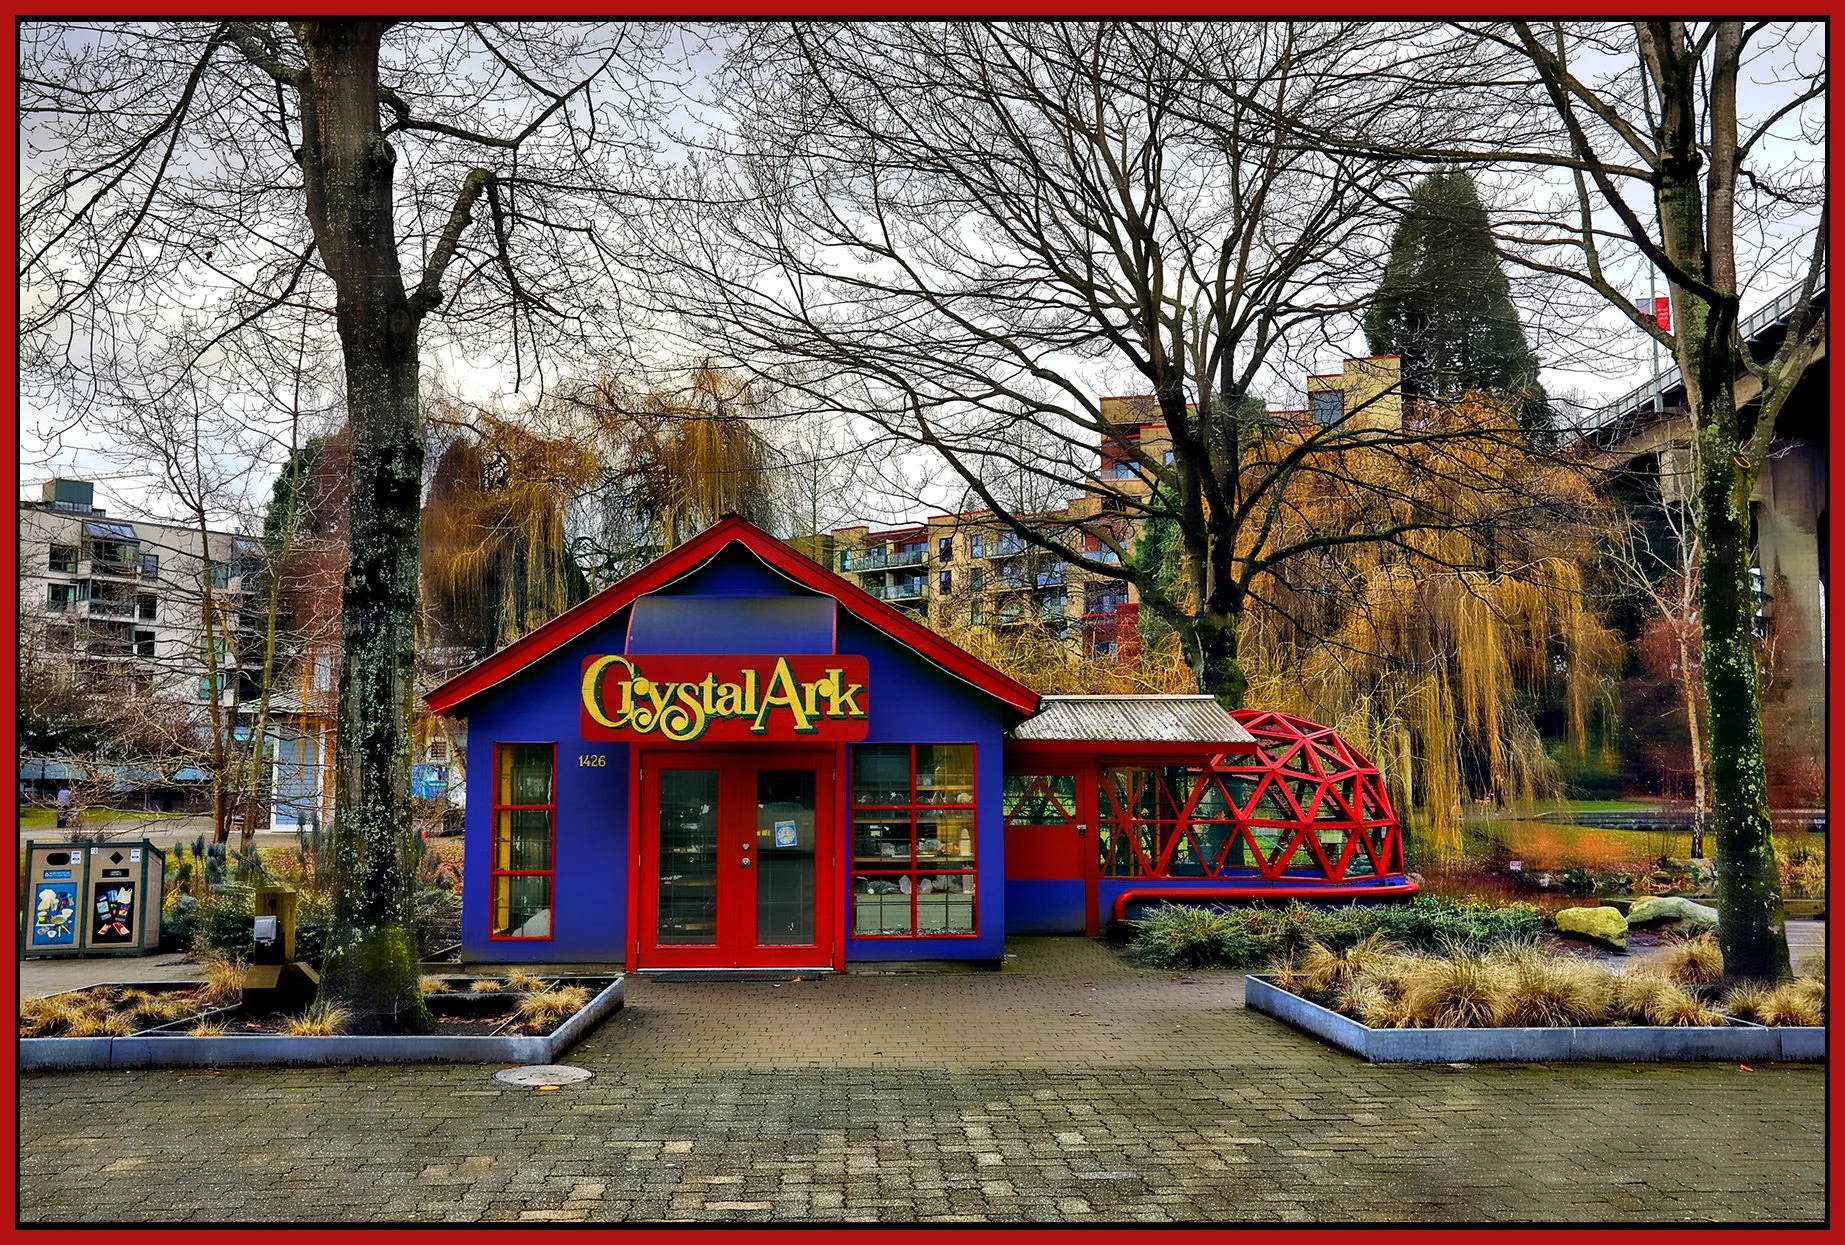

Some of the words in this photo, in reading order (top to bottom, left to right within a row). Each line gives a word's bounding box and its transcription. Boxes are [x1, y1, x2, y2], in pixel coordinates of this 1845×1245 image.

[581, 654, 759, 742] Crystal
[750, 656, 866, 734] Ark
[578, 754, 606, 768] 1426
